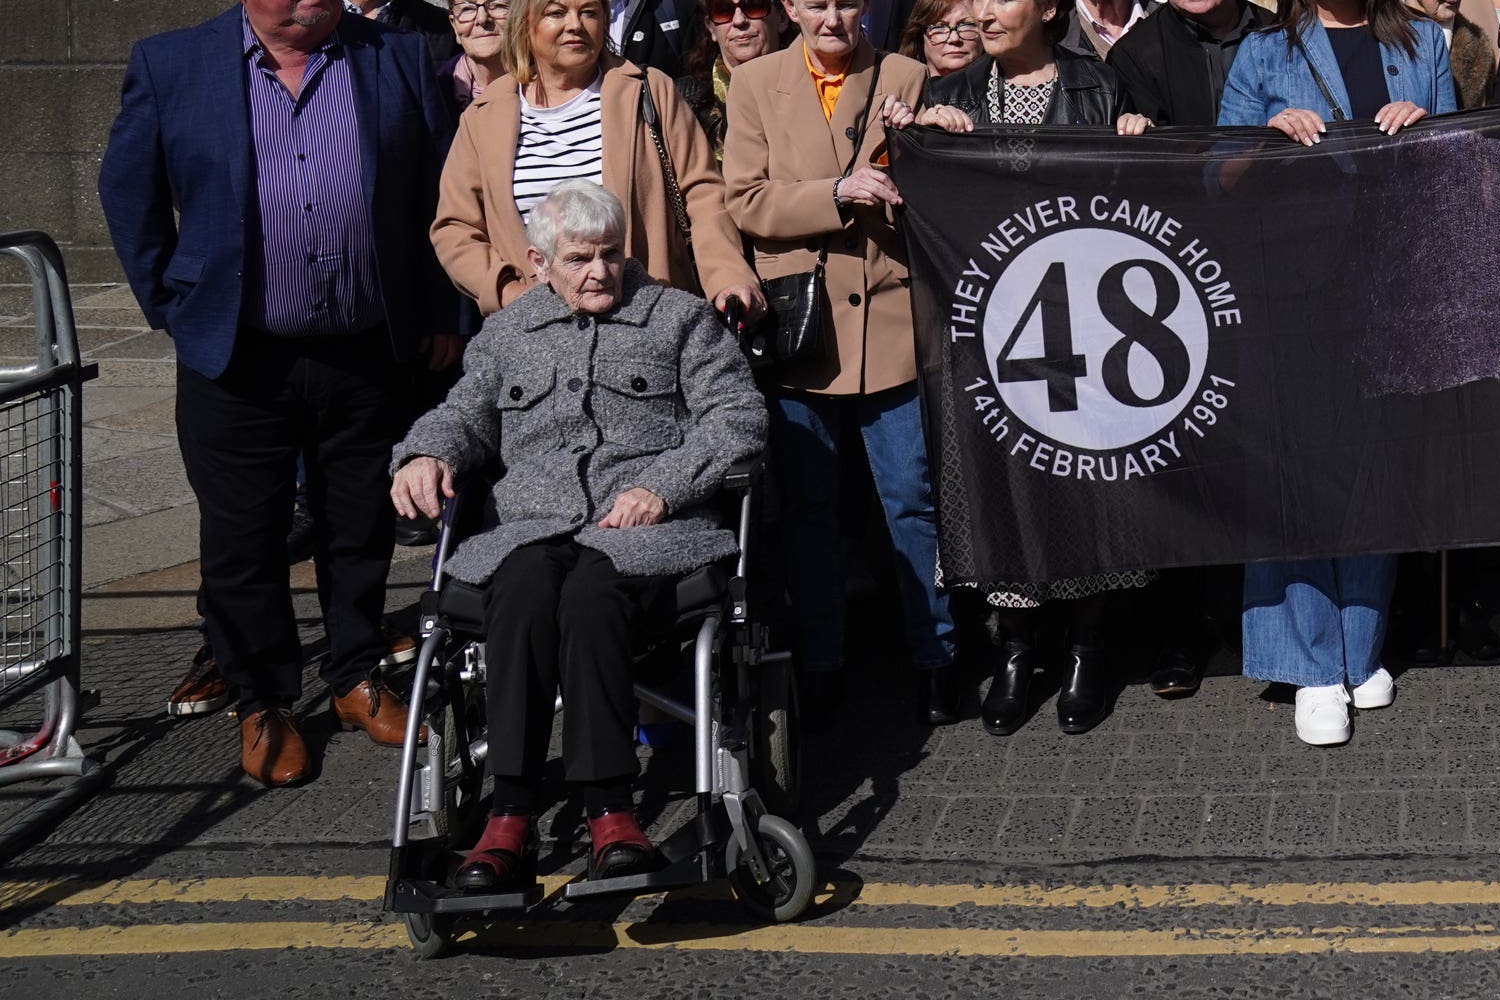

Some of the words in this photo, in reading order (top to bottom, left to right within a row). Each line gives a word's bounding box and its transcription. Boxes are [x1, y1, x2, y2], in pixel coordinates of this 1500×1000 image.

[952, 258, 990, 342] THEY
[981, 196, 1080, 261] NEVER
[1090, 195, 1182, 246] CAME
[1178, 238, 1242, 327] HOME
[996, 258, 1190, 413] 48
[964, 376, 1008, 442] 14th
[1010, 431, 1182, 481] FEBRUARY
[1184, 374, 1236, 438] 1981
